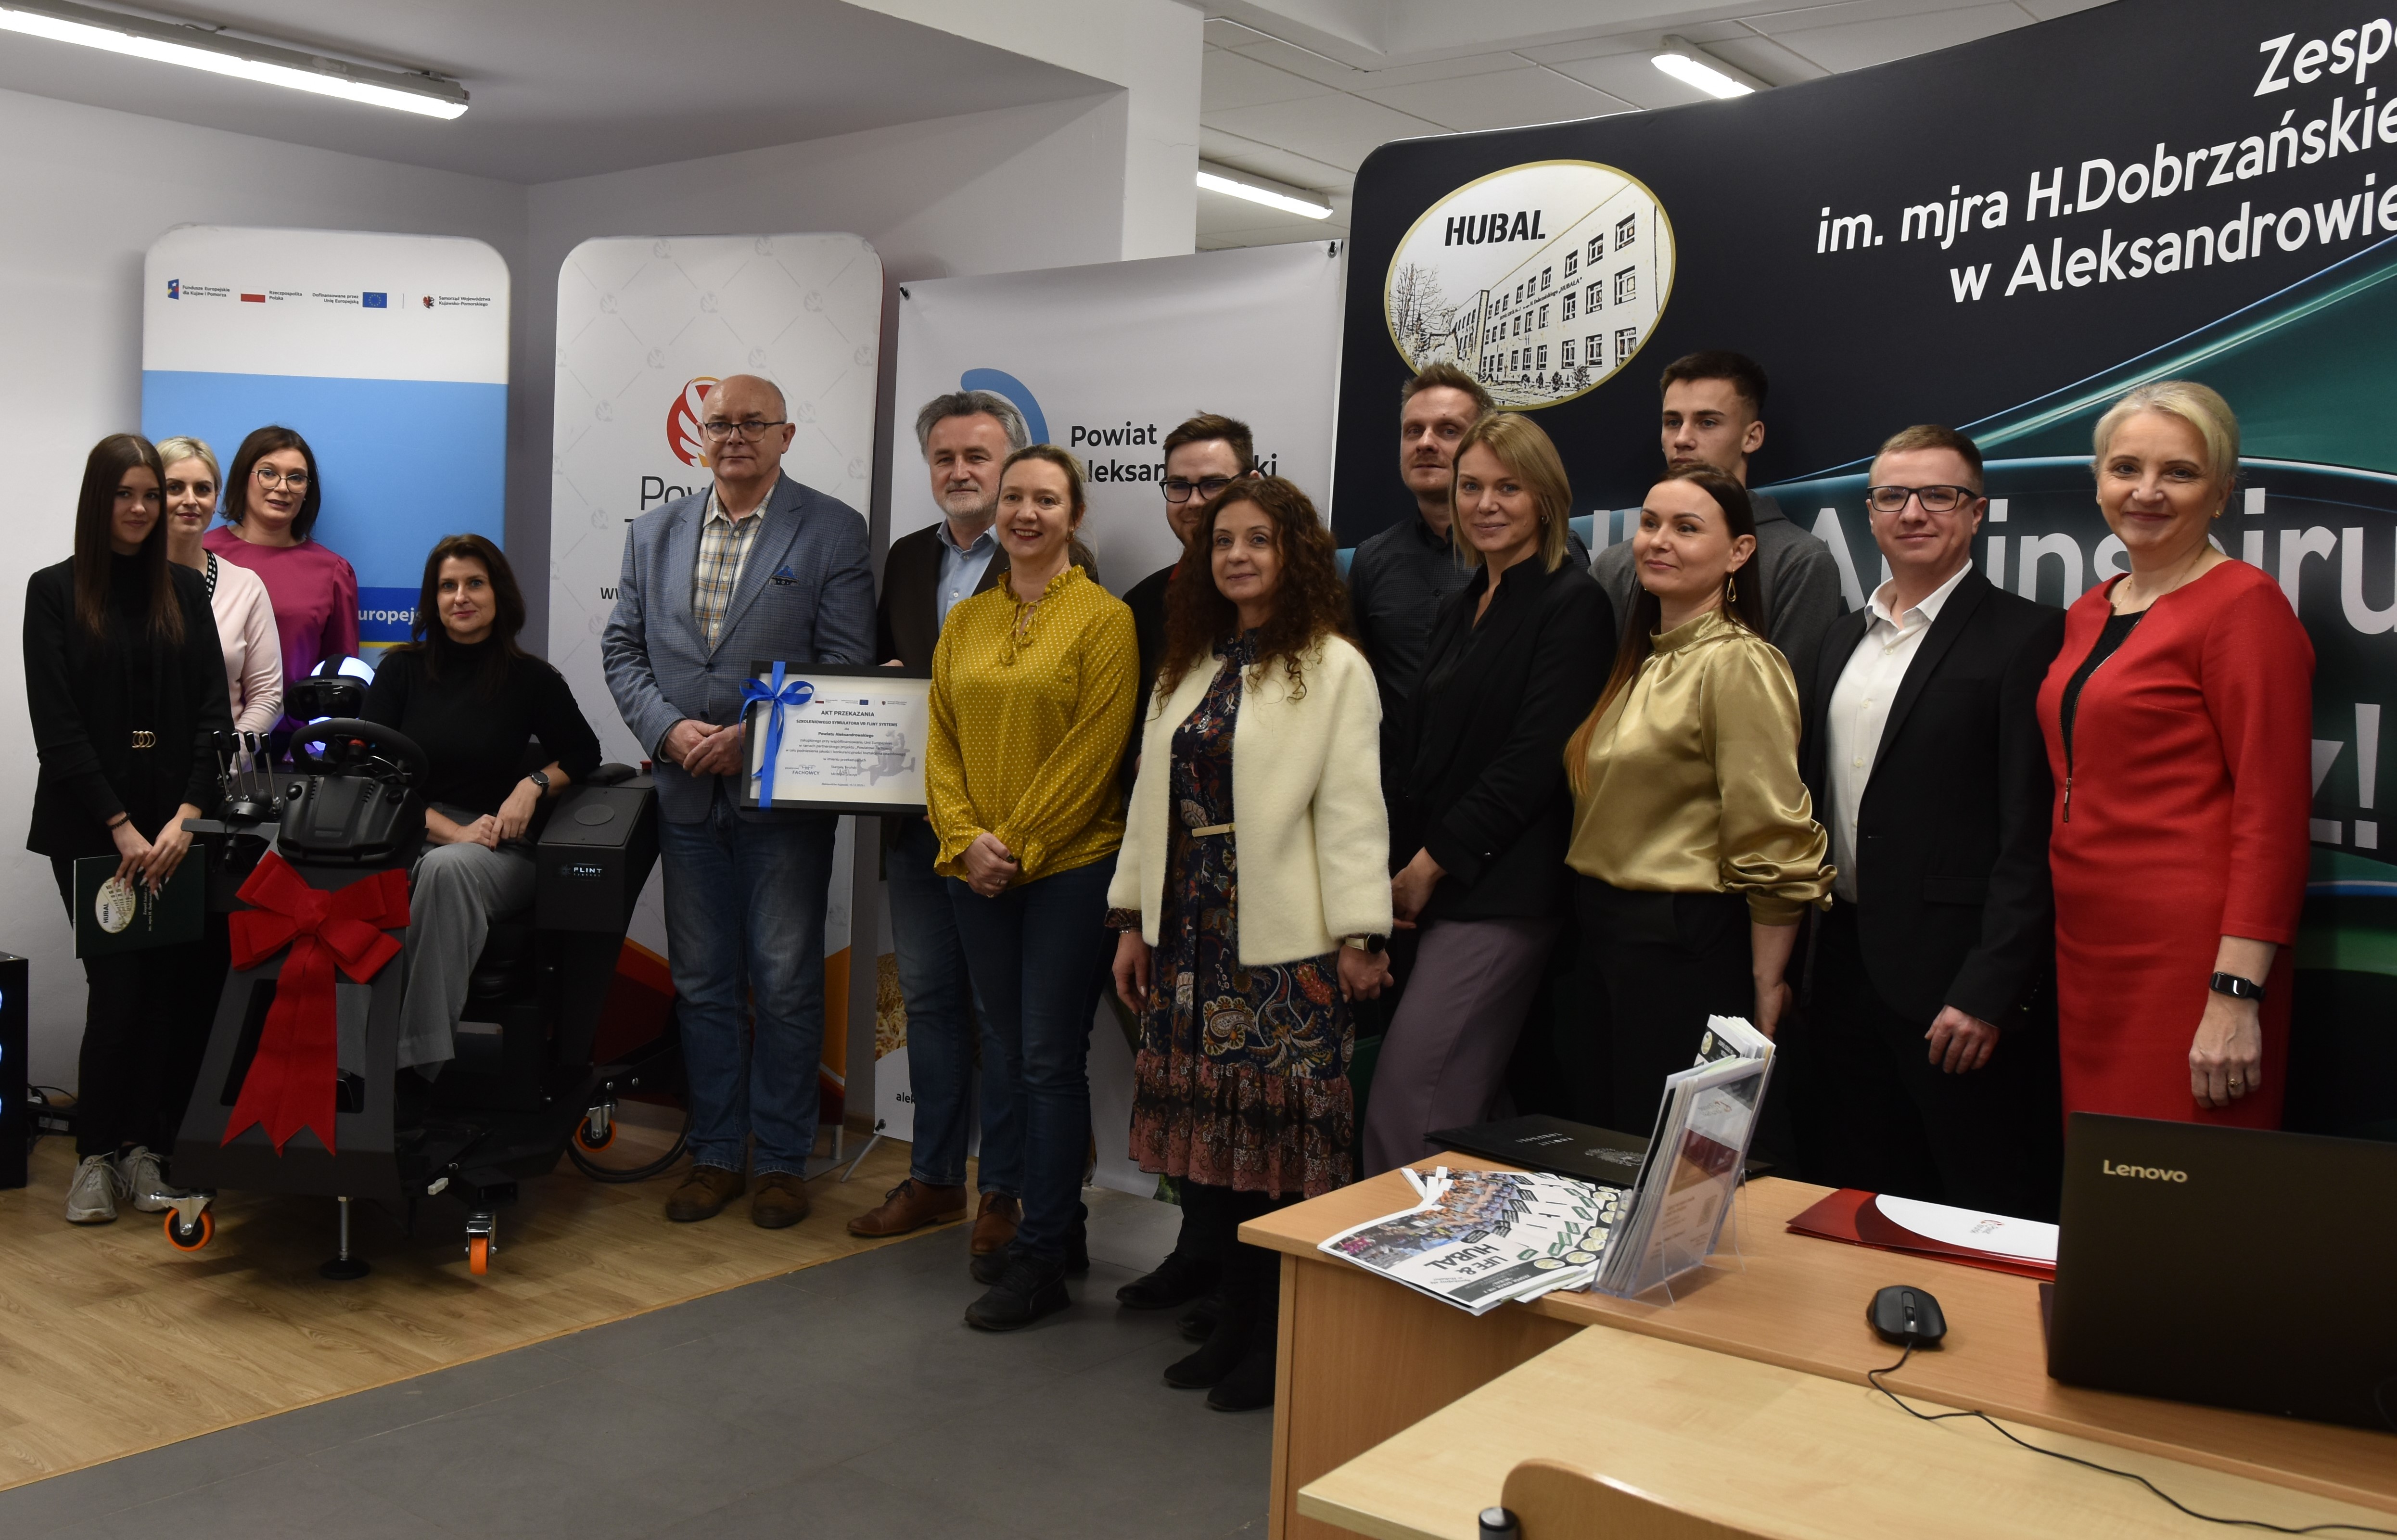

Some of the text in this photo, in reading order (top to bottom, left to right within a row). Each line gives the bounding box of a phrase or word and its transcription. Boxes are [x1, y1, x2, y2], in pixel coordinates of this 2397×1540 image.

[2254, 18, 2397, 96] Zesp
[1445, 210, 1545, 246] HUBAL
[1817, 207, 1884, 254] im.
[1901, 185, 2008, 249] mjra
[1950, 261, 1991, 303] w
[1071, 421, 1157, 447] Powiat
[358, 607, 421, 625] uropej
[2103, 1159, 2188, 1183] Lenovo
[1423, 1243, 1501, 1270] HUBAL
[1455, 1255, 1509, 1275] LIFE &
